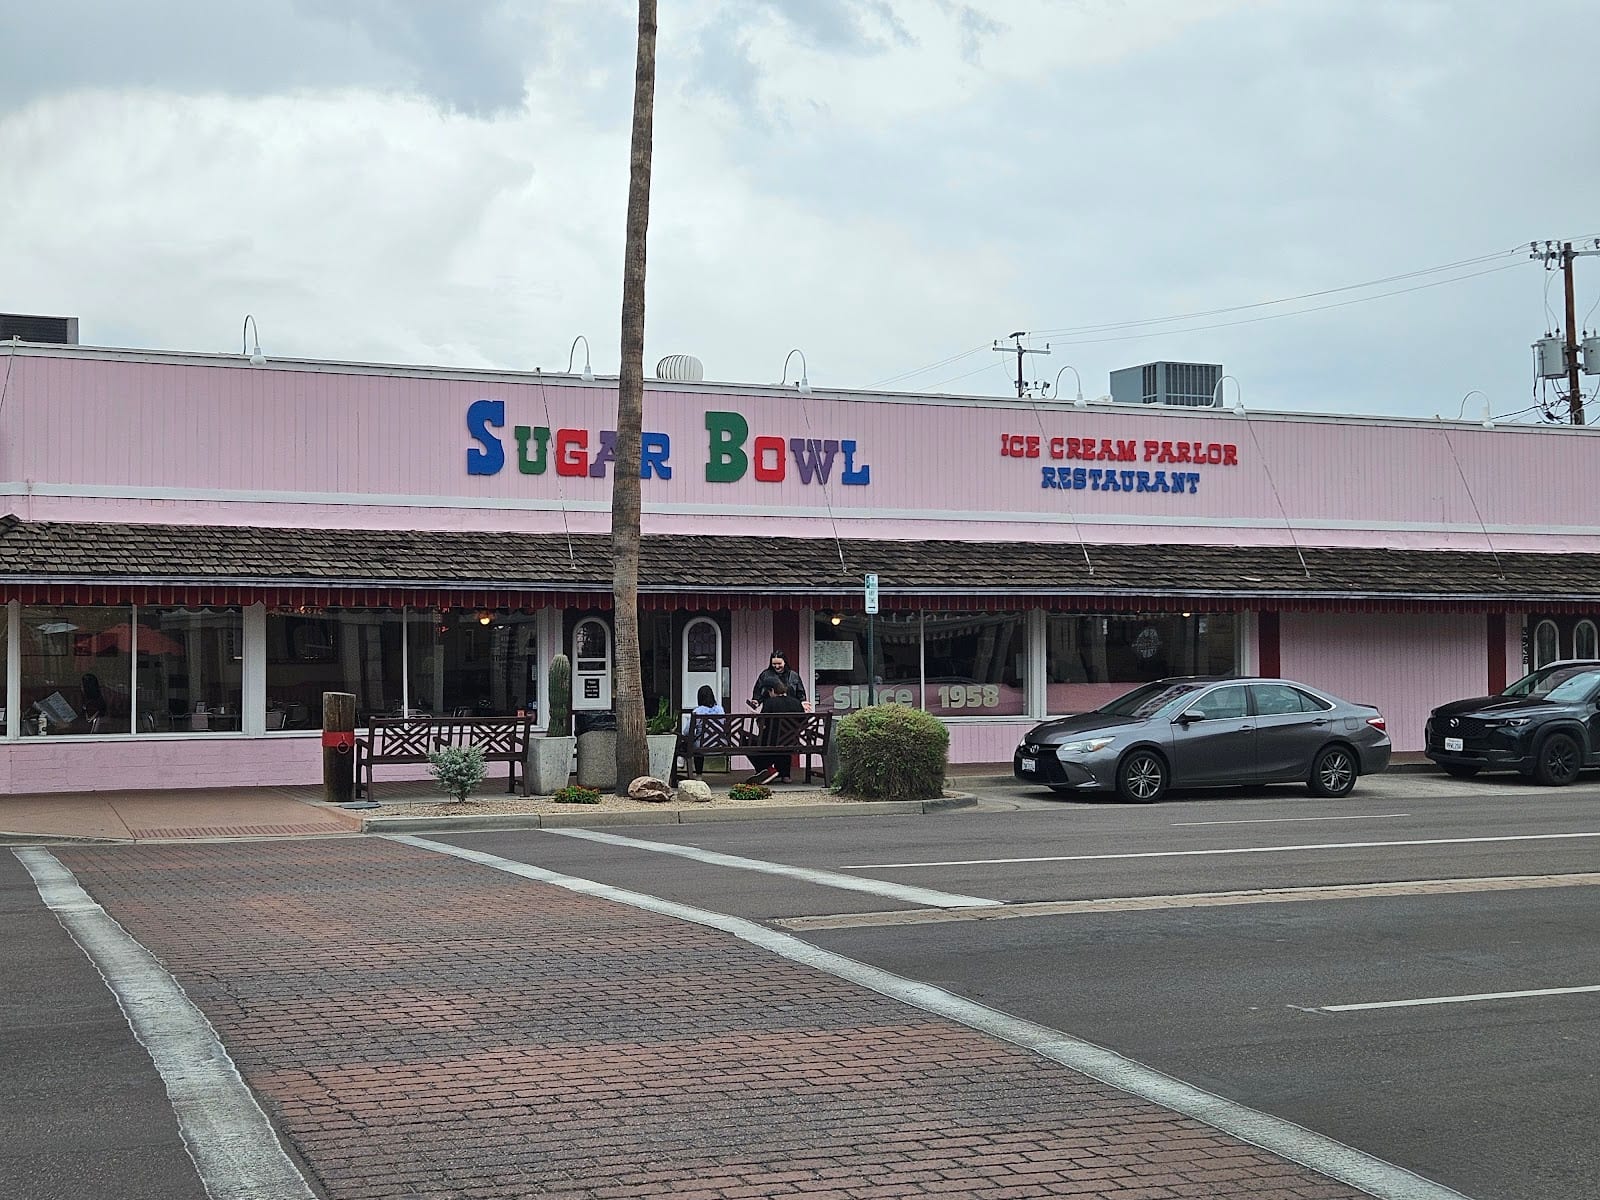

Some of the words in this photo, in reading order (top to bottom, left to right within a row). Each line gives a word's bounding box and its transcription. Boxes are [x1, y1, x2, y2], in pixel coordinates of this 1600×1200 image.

[705, 410, 870, 486] BOWL
[1001, 433, 1040, 458] ICE
[1050, 437, 1136, 462] CREAM
[1144, 440, 1238, 466] PARLOR
[1041, 466, 1200, 494] RESTAURANT
[938, 684, 999, 708] 1958
